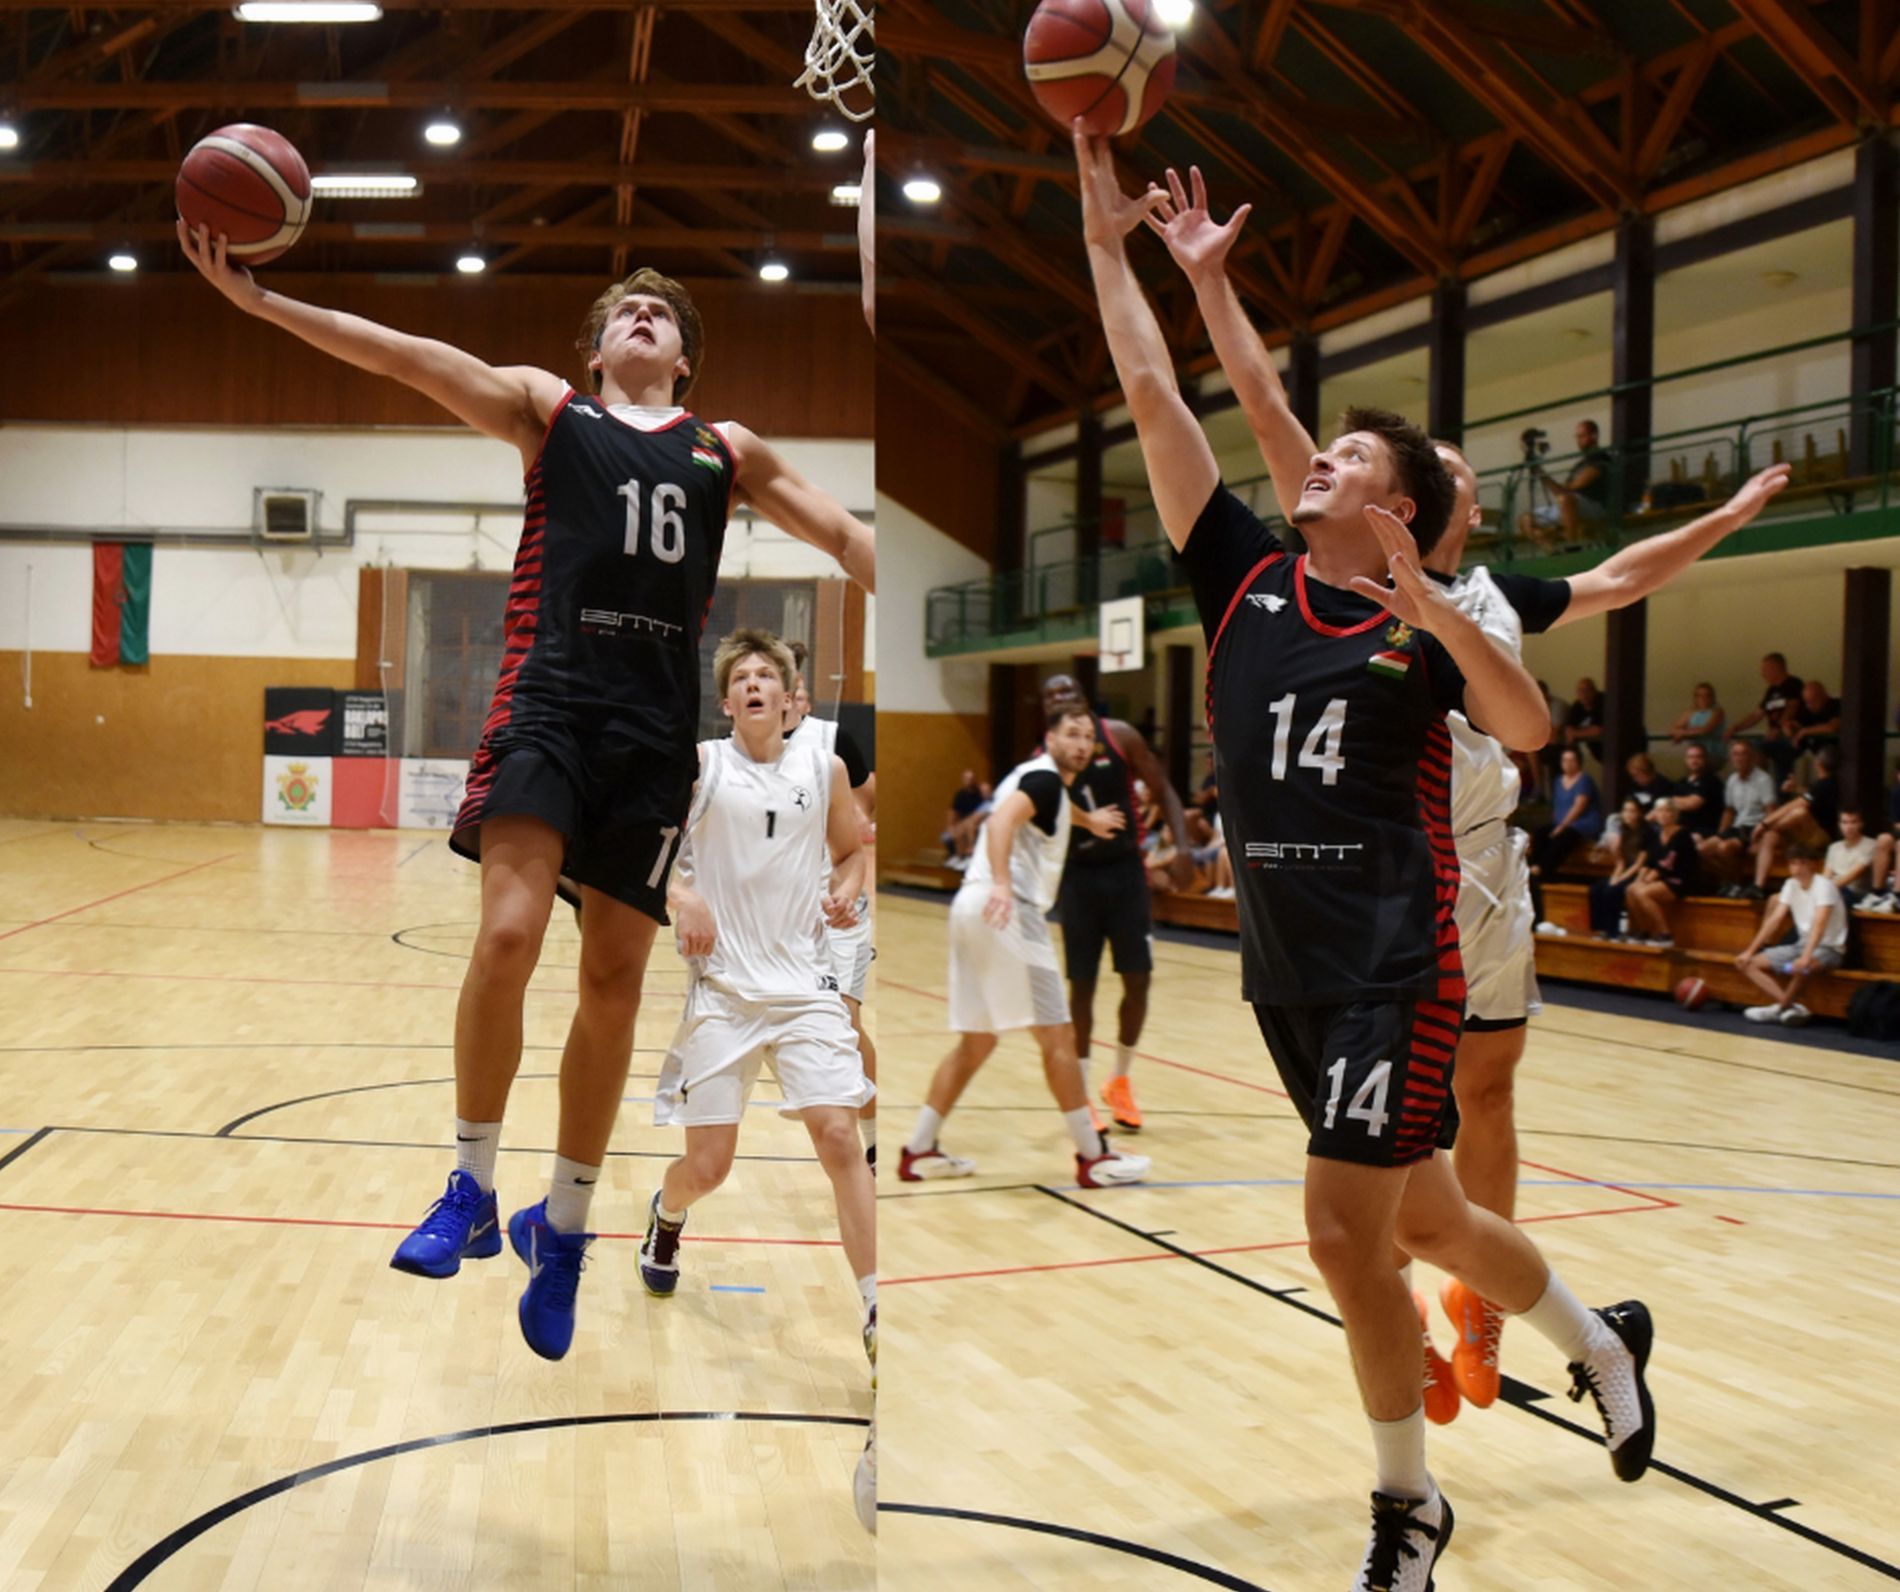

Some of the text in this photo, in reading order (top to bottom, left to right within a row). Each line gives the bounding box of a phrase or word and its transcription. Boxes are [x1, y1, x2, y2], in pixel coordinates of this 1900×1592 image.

[616, 478, 687, 564] 16
[1268, 692, 1348, 786] 14
[646, 825, 680, 889] 1
[766, 810, 777, 839] 1
[1322, 1057, 1393, 1138] 14
